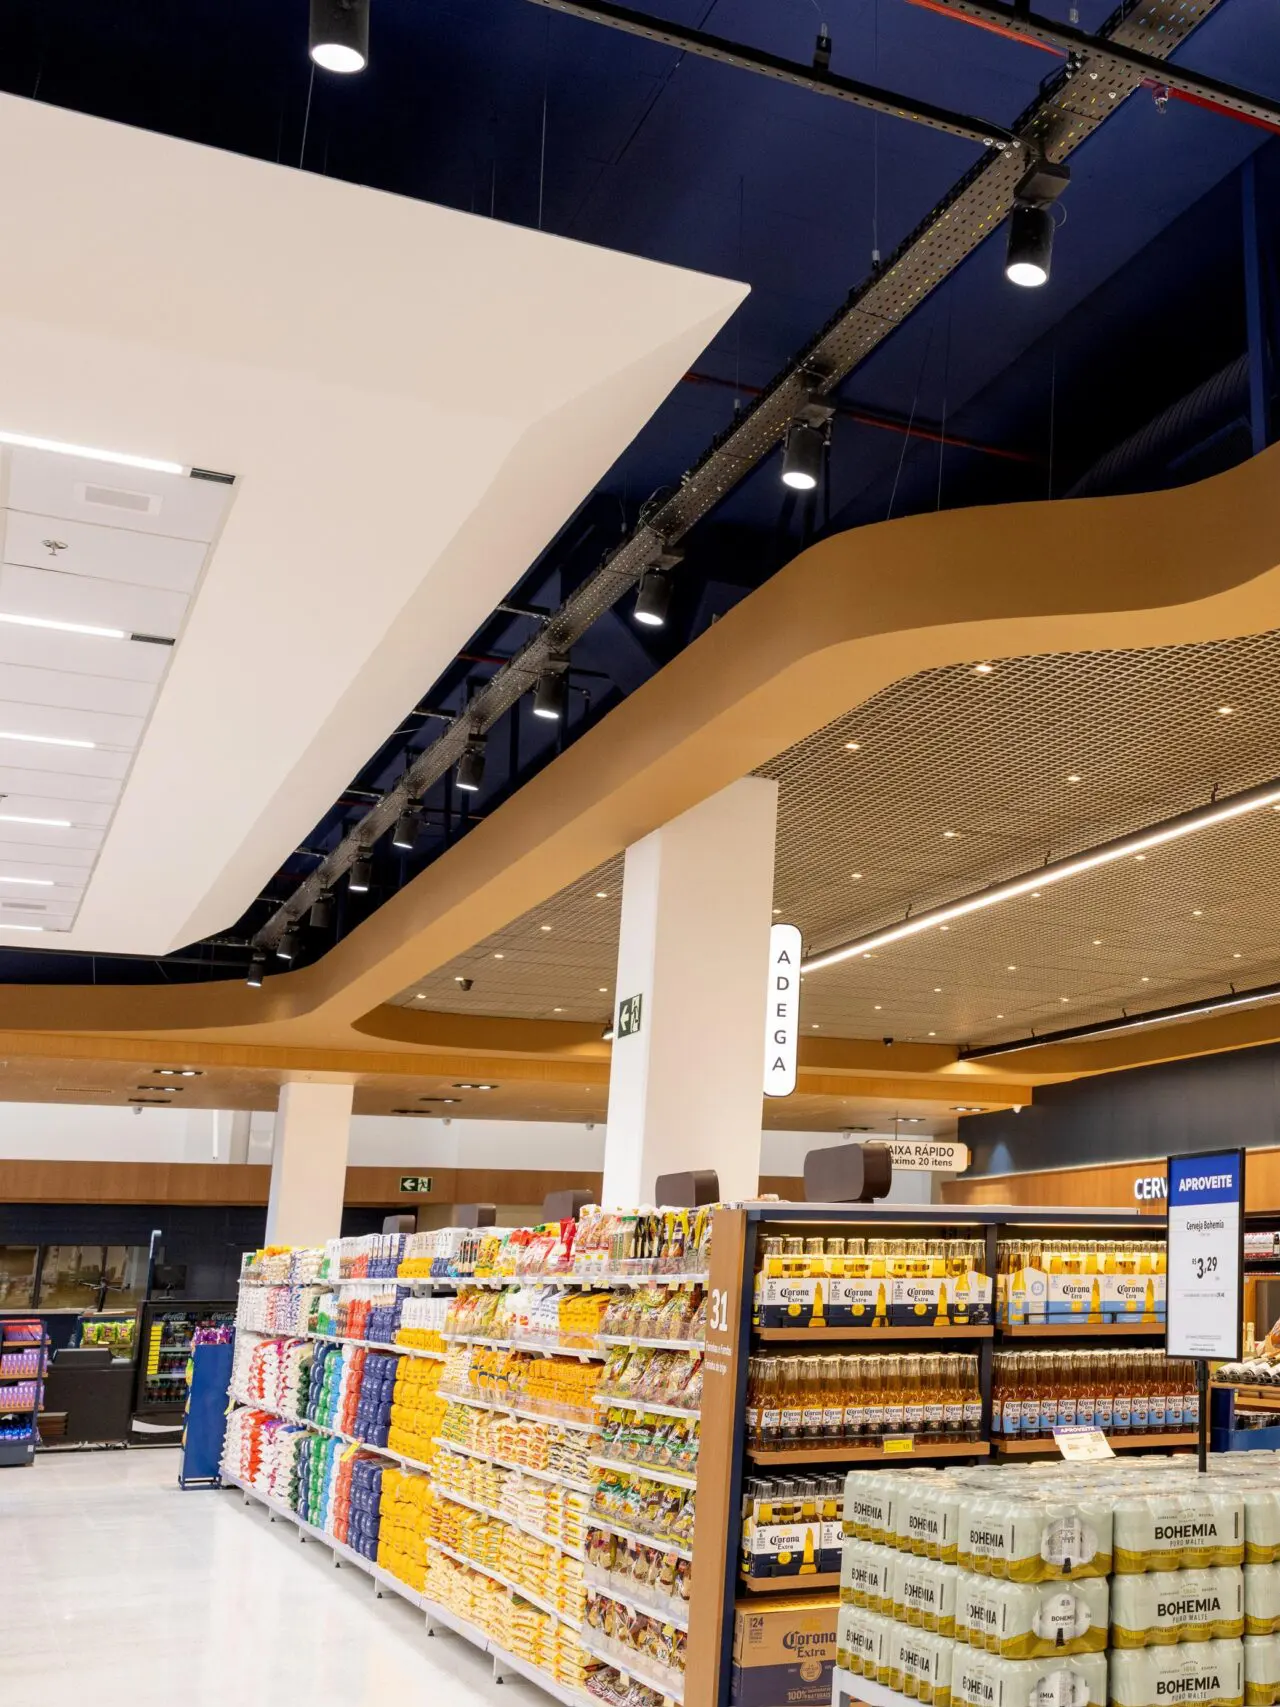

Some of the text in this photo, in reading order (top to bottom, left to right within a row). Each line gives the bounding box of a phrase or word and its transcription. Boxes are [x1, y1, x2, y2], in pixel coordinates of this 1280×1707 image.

[771, 949, 791, 1072] ADEGA
[889, 1144, 954, 1157] AIXA RÁPIDO
[891, 1156, 952, 1166] áximo 20 itens
[1134, 1176, 1168, 1199] CERV
[1178, 1174, 1232, 1192] APROVEITE
[1186, 1219, 1224, 1232] Cerveja Bohemia
[1197, 1256, 1217, 1279] 3,29
[780, 1288, 809, 1297] Corona
[844, 1288, 873, 1297] Corona
[907, 1287, 934, 1296] Corona
[1062, 1284, 1090, 1294] Corona
[1117, 1284, 1144, 1294] Corona
[710, 1288, 728, 1332] 31
[1155, 1524, 1217, 1540] BOHEMIA
[770, 1535, 800, 1545] Corona
[1158, 1597, 1220, 1617] BOHEMIA
[752, 1618, 764, 1628] 24
[783, 1630, 837, 1650] Corona
[797, 1646, 826, 1658] Extra
[1157, 1676, 1220, 1695] BOHEMIA
